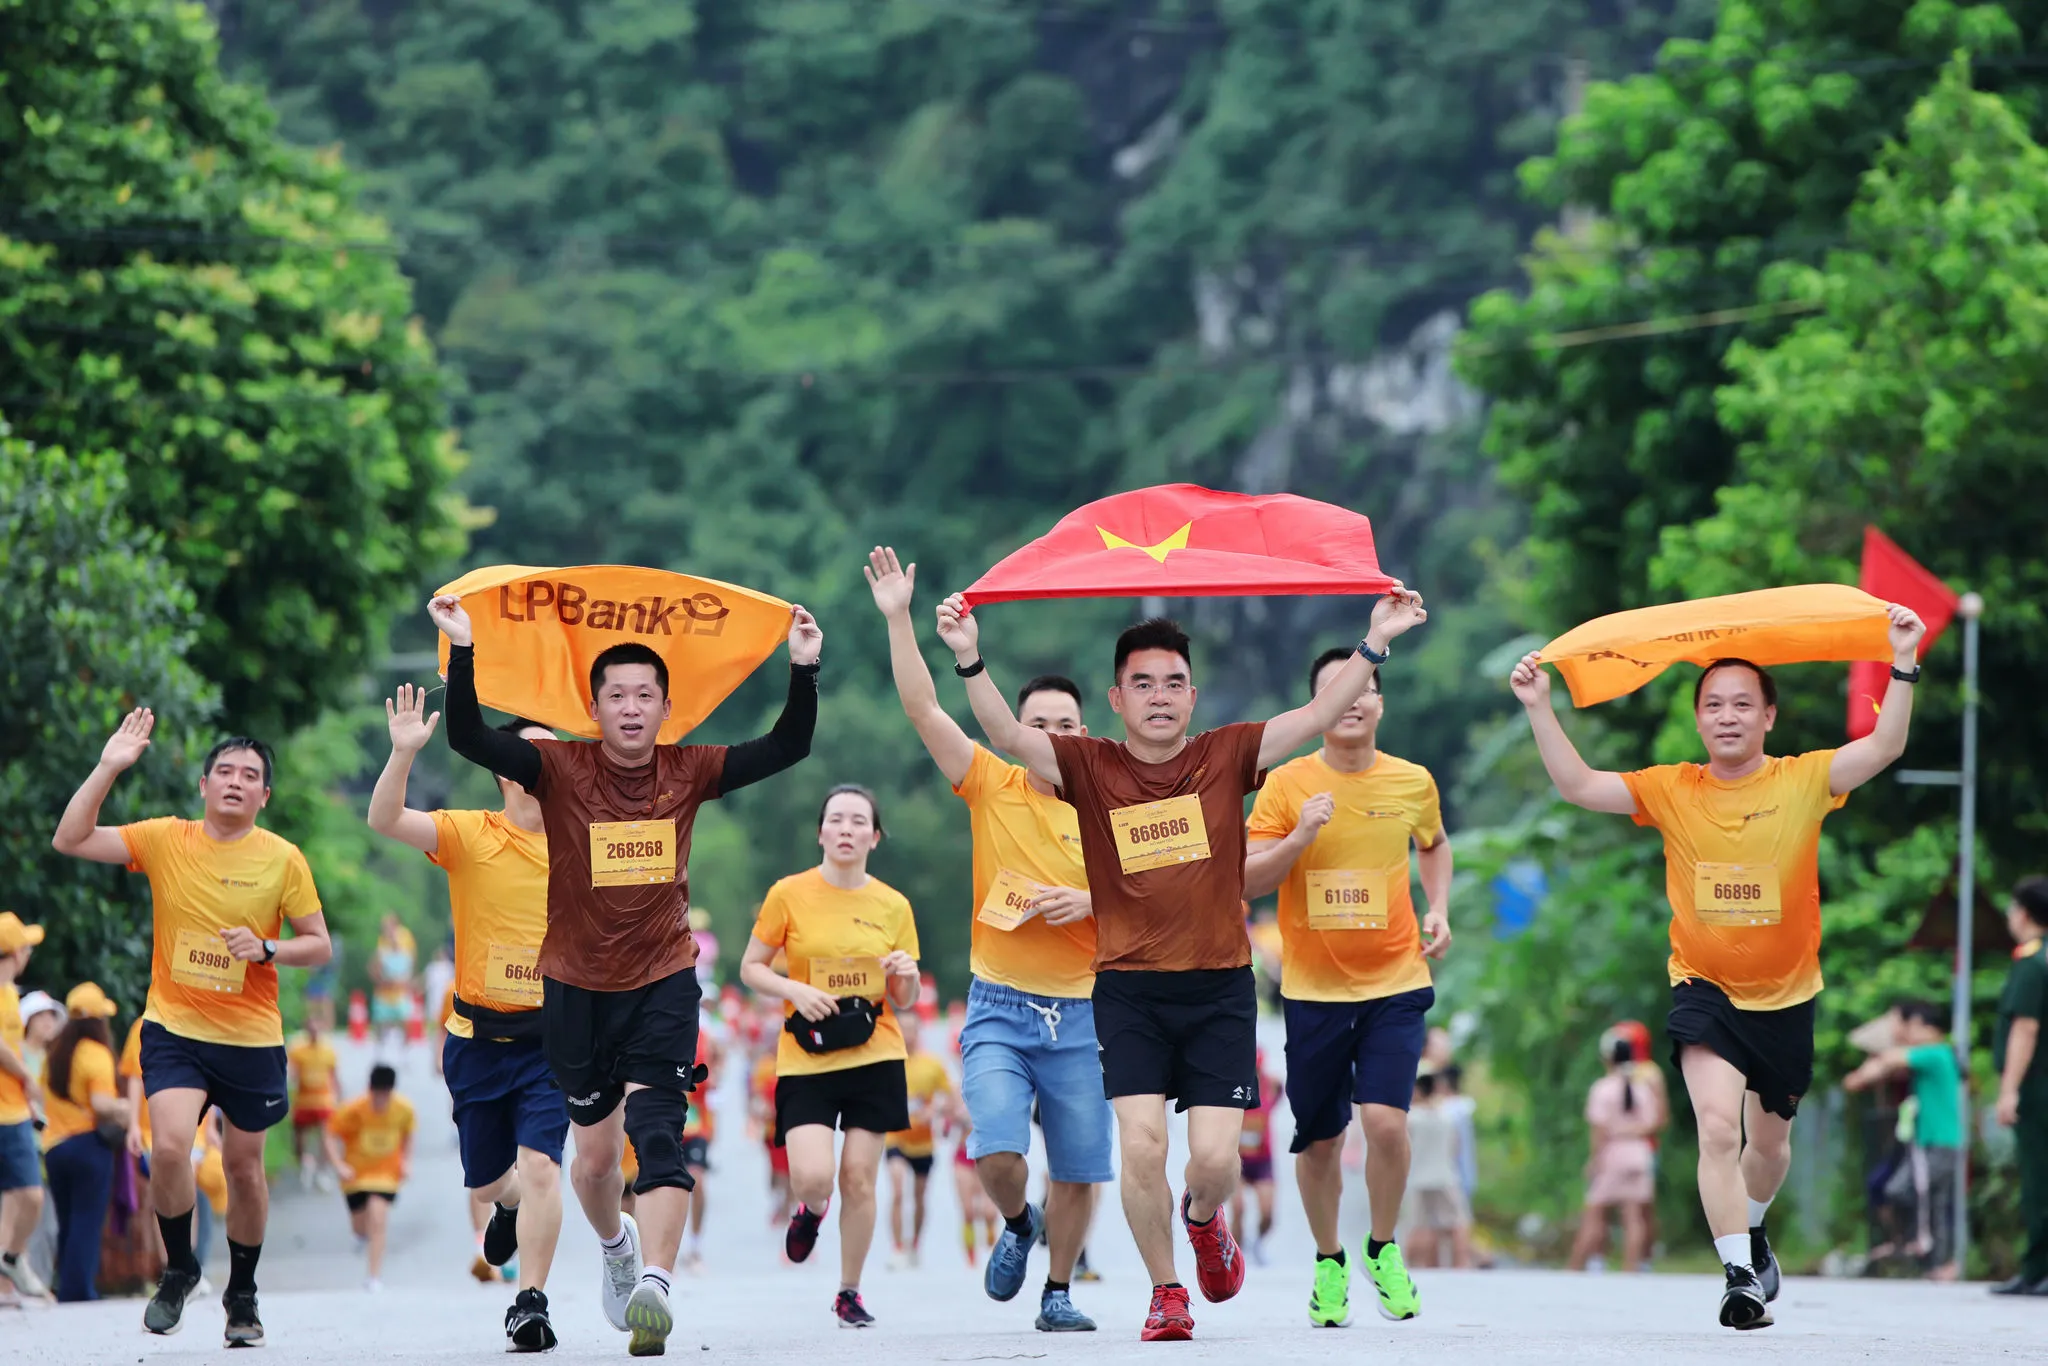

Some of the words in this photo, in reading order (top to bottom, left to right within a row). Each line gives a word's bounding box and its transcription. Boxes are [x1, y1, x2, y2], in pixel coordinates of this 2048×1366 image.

[501, 580, 675, 635] LPBank
[1130, 817, 1189, 844] 868686
[607, 841, 663, 859] 268268
[1325, 889, 1369, 904] 61686
[1714, 884, 1761, 900] 66896
[189, 949, 230, 969] 63988
[505, 964, 544, 981] 6646
[828, 972, 867, 988] 69461
